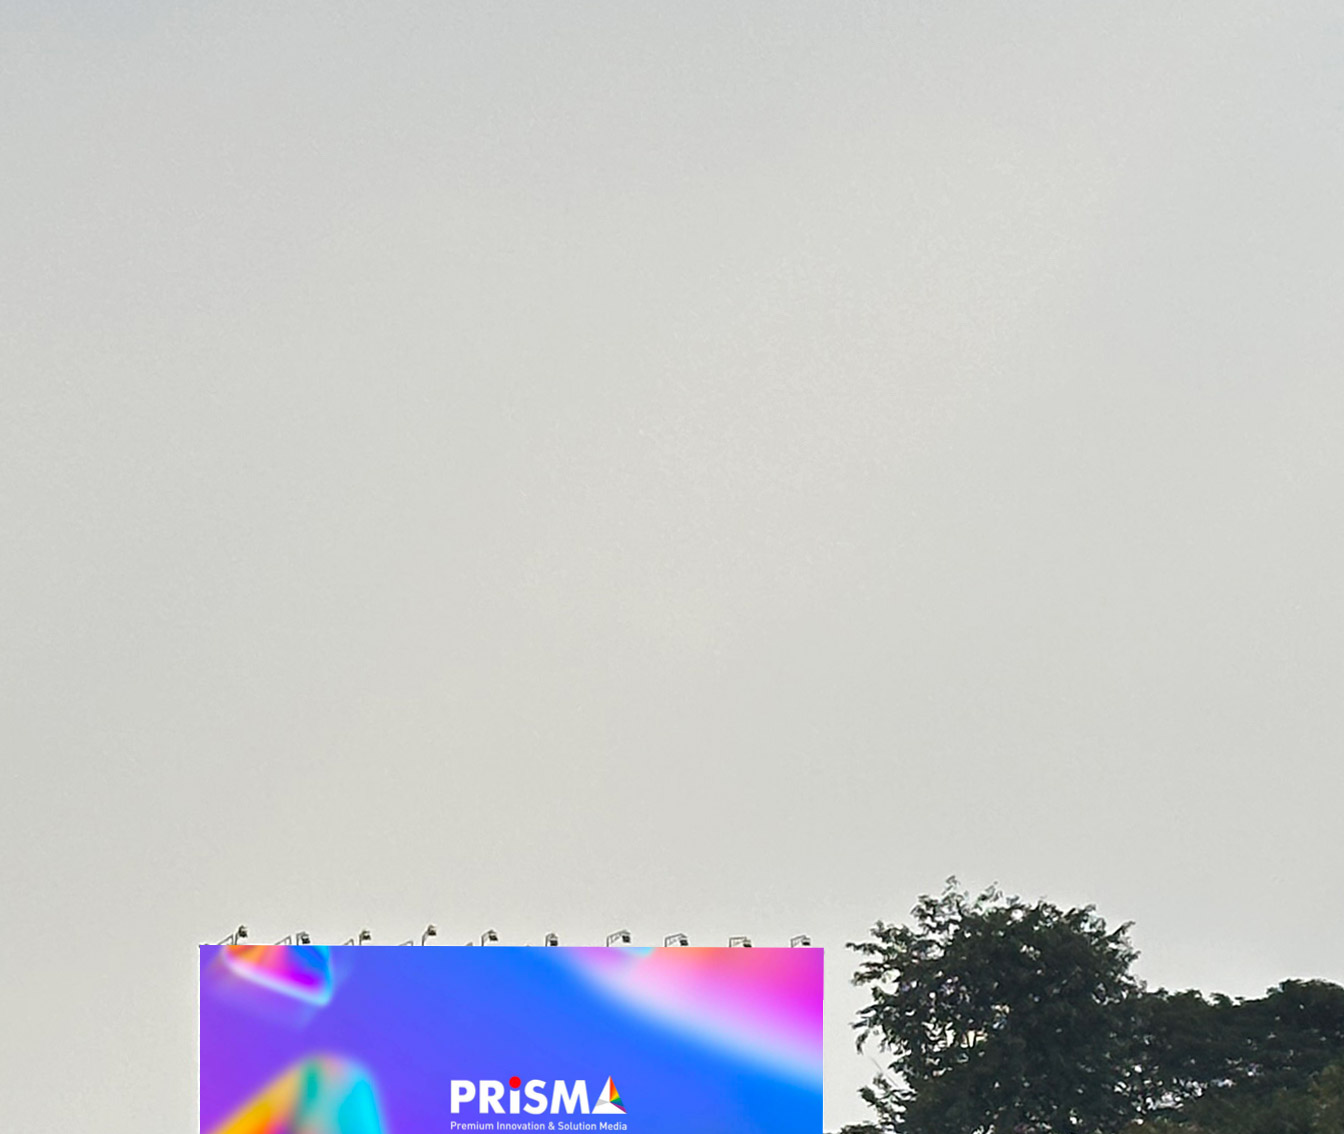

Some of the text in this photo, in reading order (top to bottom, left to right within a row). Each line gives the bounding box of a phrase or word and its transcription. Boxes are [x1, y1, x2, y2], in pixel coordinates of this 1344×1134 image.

[450, 1121, 628, 1131] Premium Innovation & Solution Media
